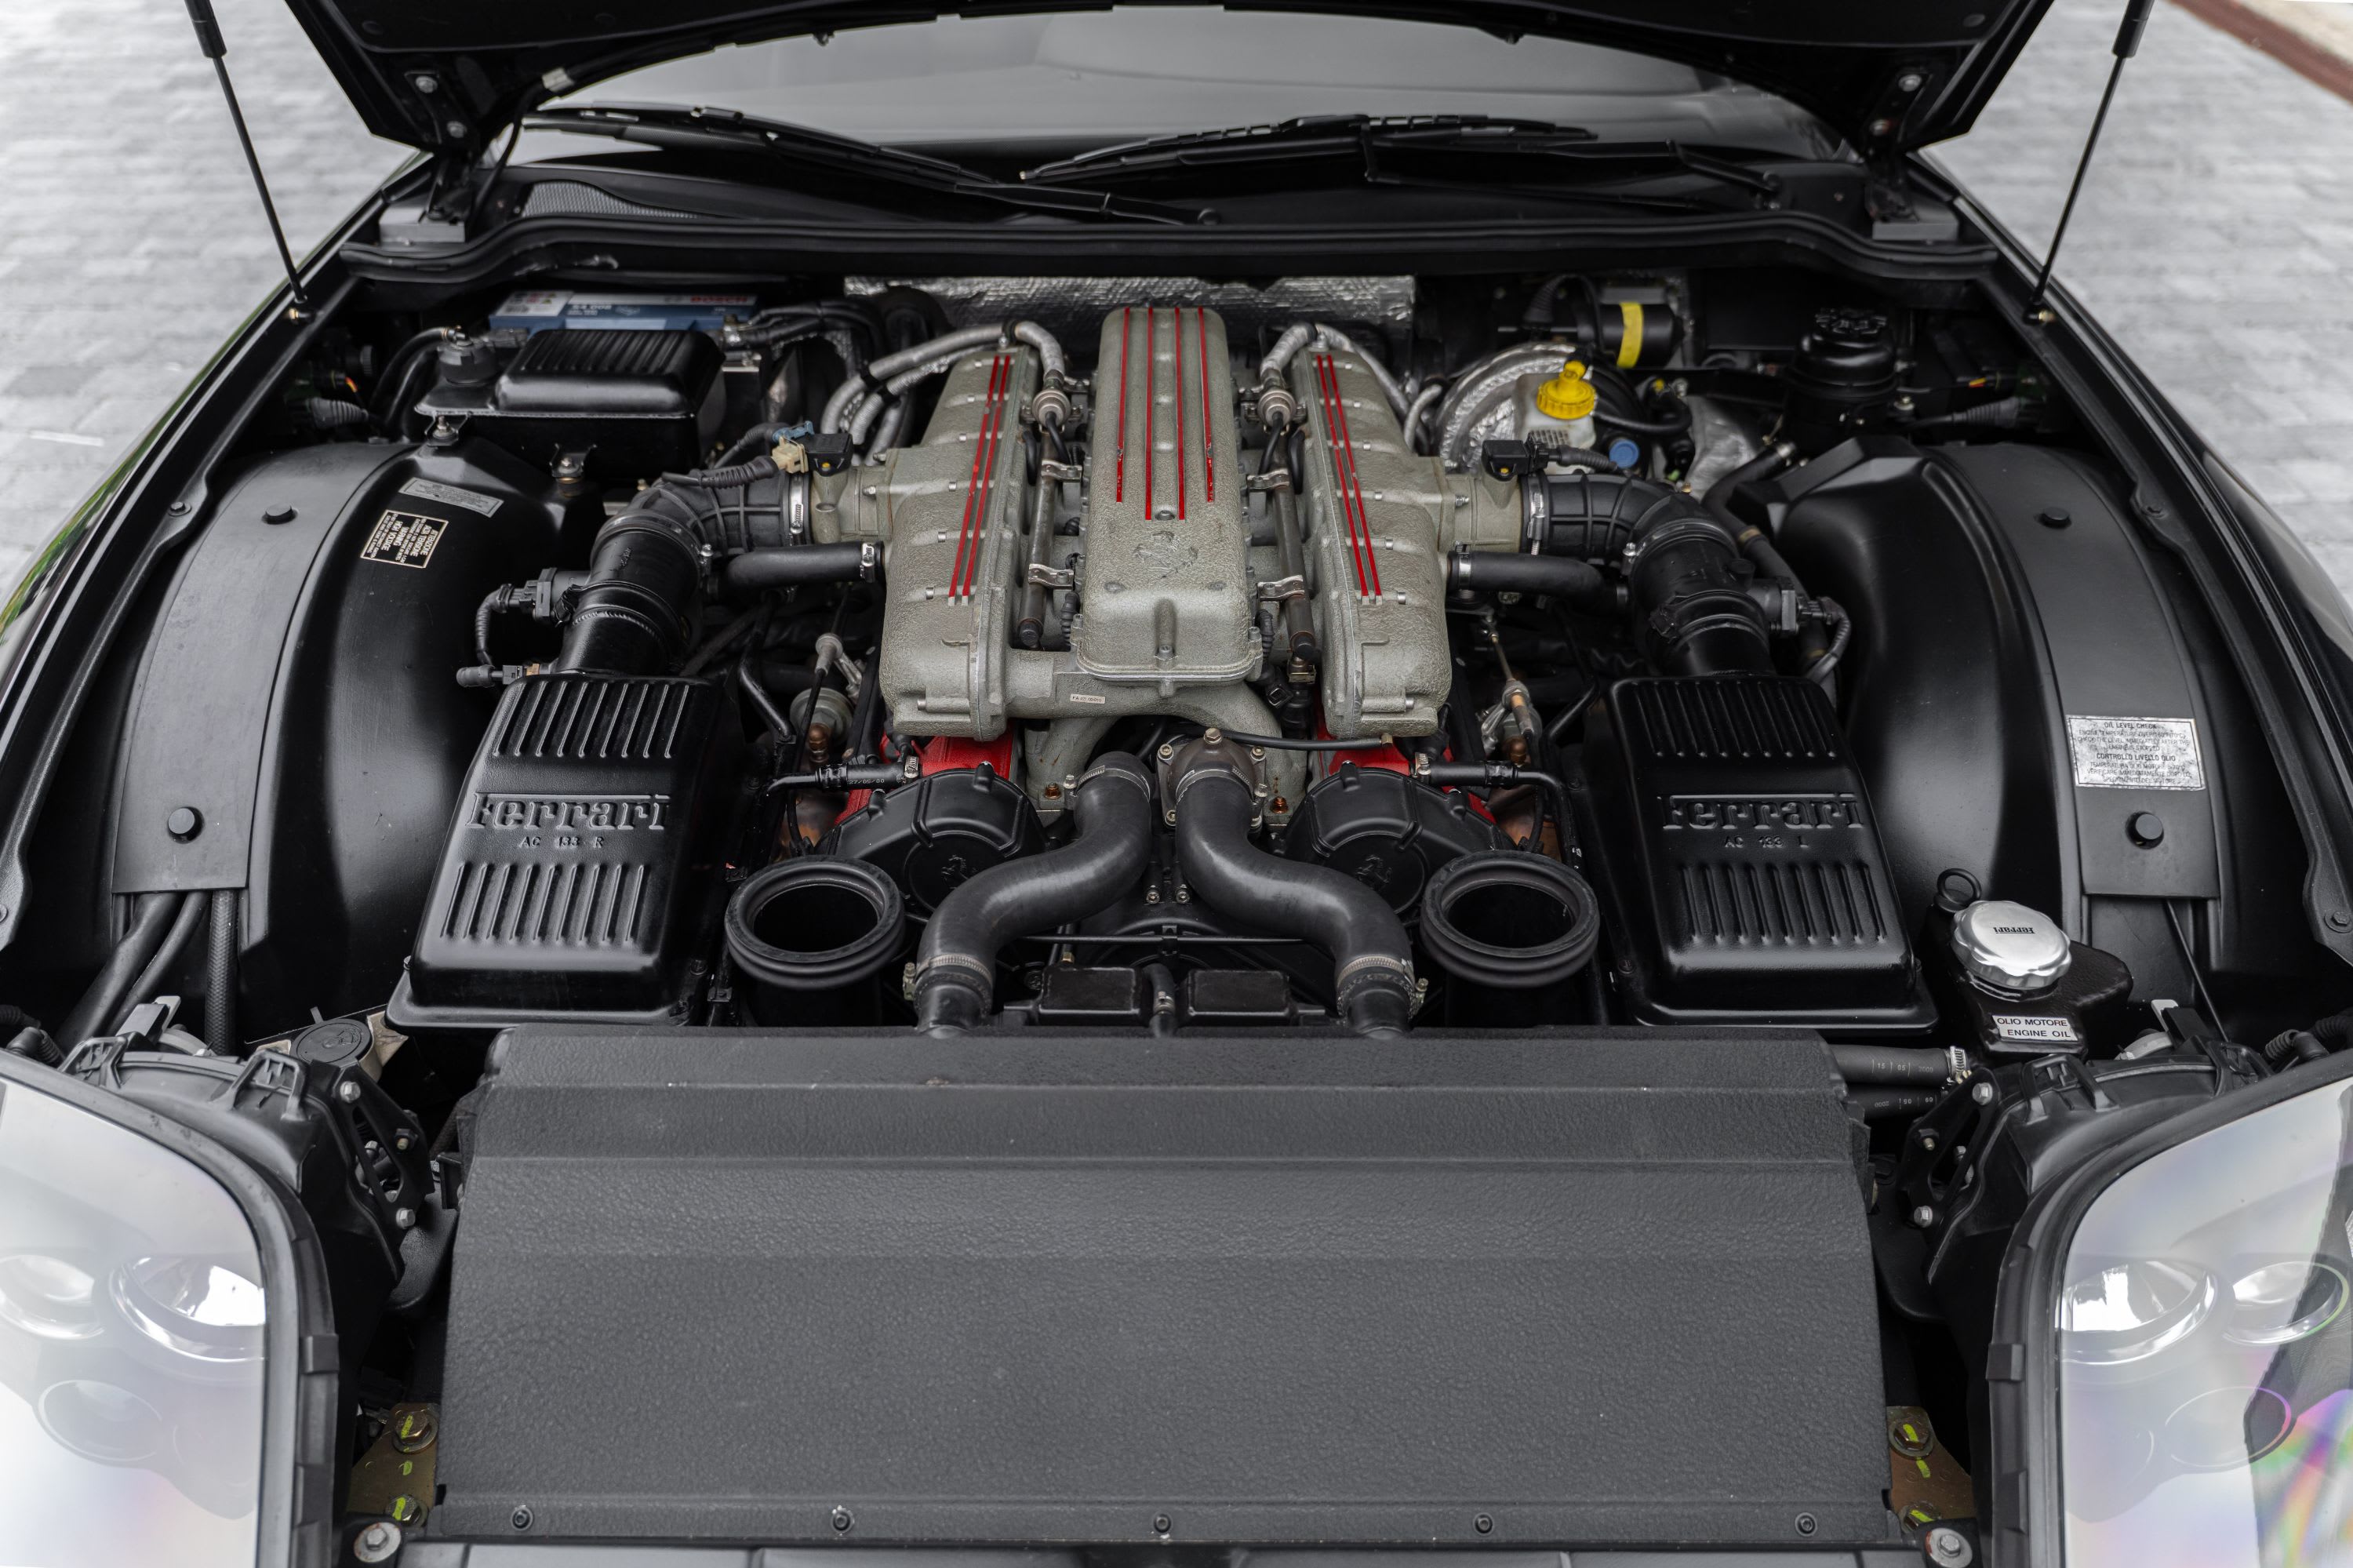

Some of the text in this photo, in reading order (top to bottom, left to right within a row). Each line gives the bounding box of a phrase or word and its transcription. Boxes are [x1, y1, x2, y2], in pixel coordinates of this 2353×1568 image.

[464, 792, 671, 830] Ferrari
[1657, 792, 1864, 830] Ferrari
[518, 836, 605, 849] AC 133 R
[1724, 835, 1809, 848] AC 133 L
[2024, 1018, 2068, 1027] MOTORE
